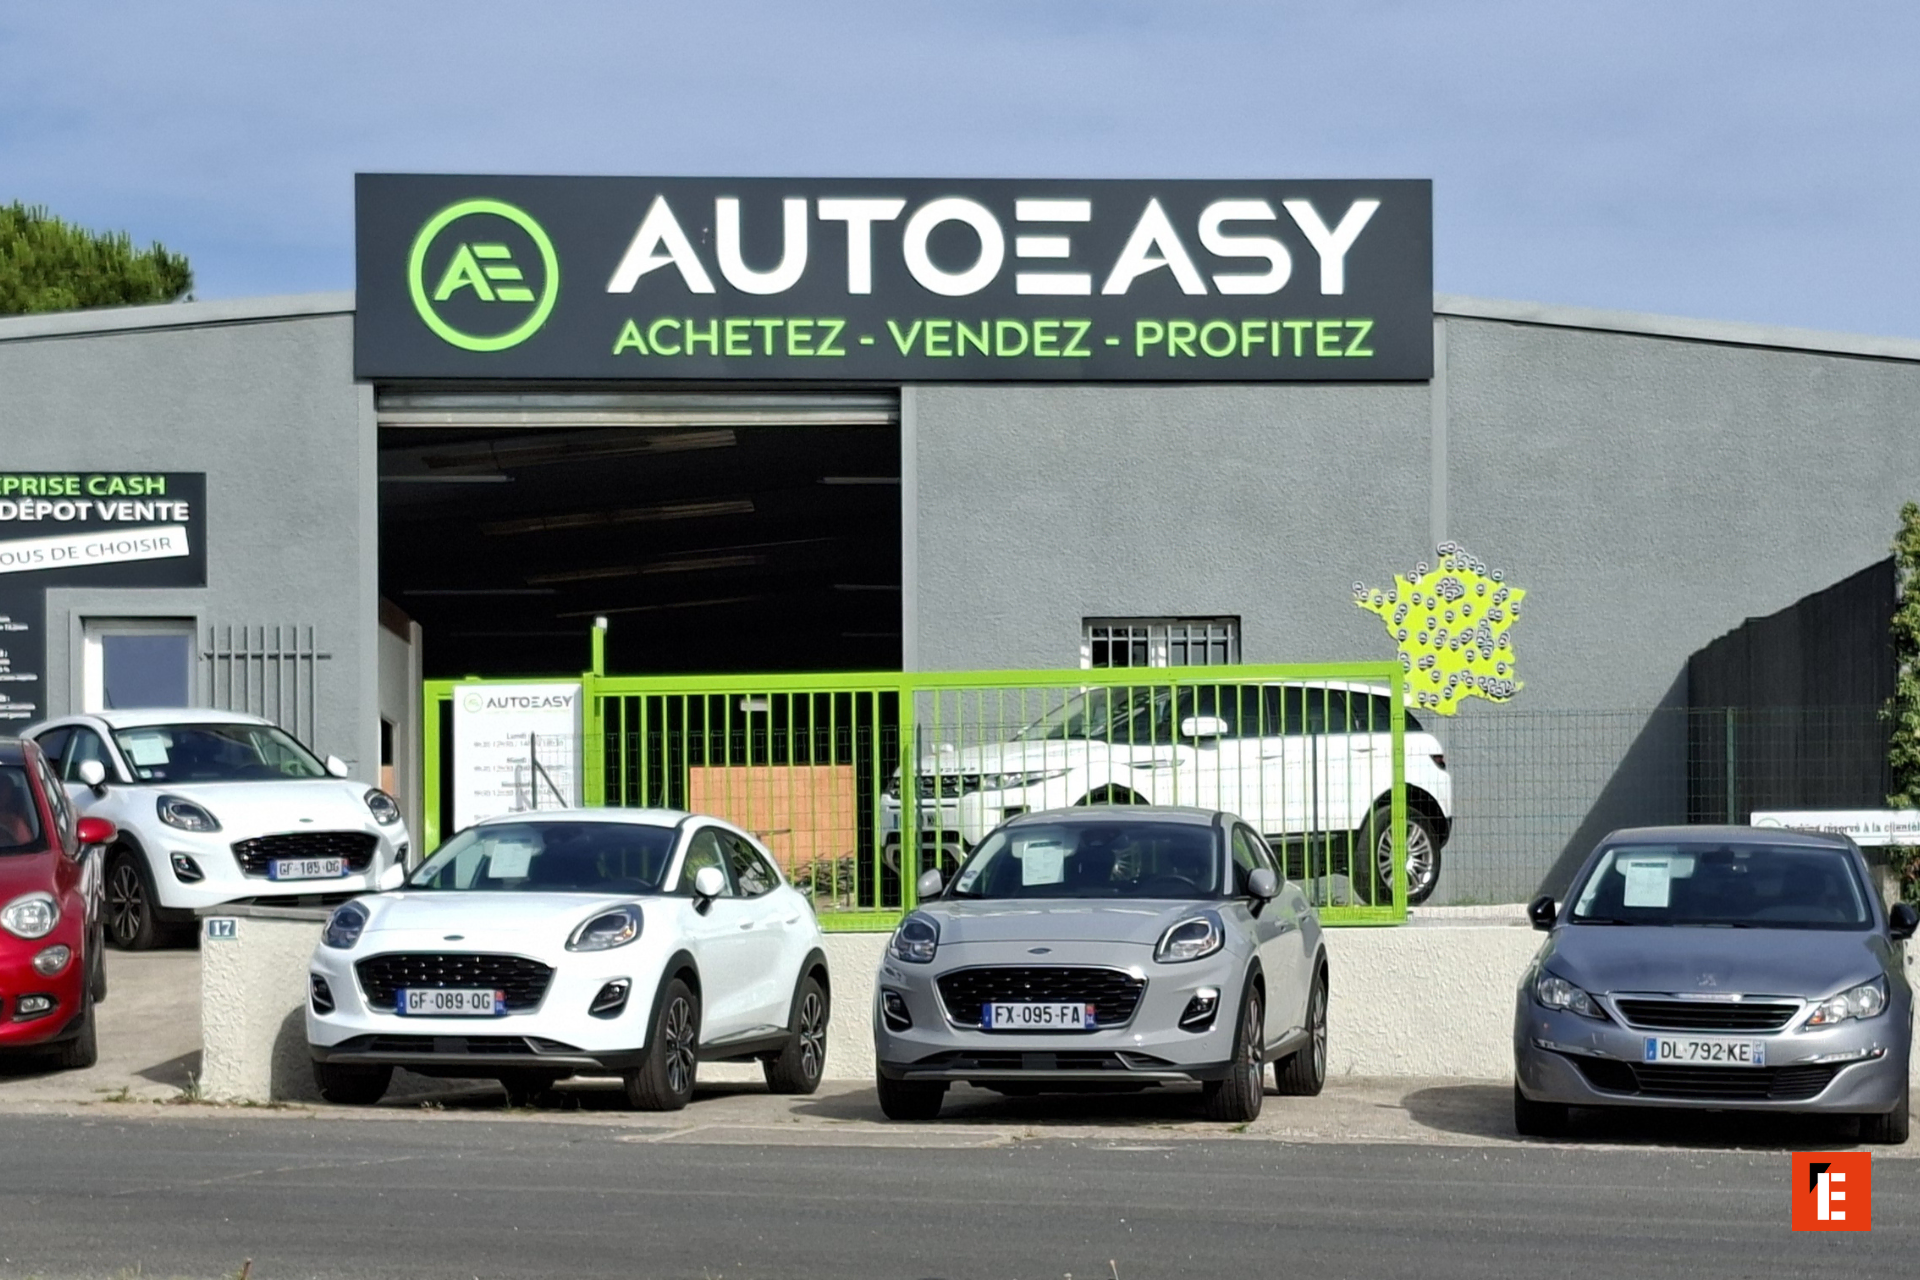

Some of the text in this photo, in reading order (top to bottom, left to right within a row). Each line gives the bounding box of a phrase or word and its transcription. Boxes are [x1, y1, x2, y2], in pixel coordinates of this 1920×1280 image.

[606, 195, 1382, 297] AUTOEASY
[613, 319, 846, 357] ACHETEZ
[886, 320, 1092, 358] VENDEZ
[1136, 320, 1374, 358] PROFITEZ
[0, 476, 166, 495] PRISE CASH
[0, 498, 190, 521] DÉPOT VENTE
[51, 546, 80, 561] DE
[85, 537, 172, 558] CHOISIR
[486, 695, 573, 709] AUTOEASY
[213, 921, 232, 936] 17
[994, 1005, 1080, 1024] FX-095-FA
